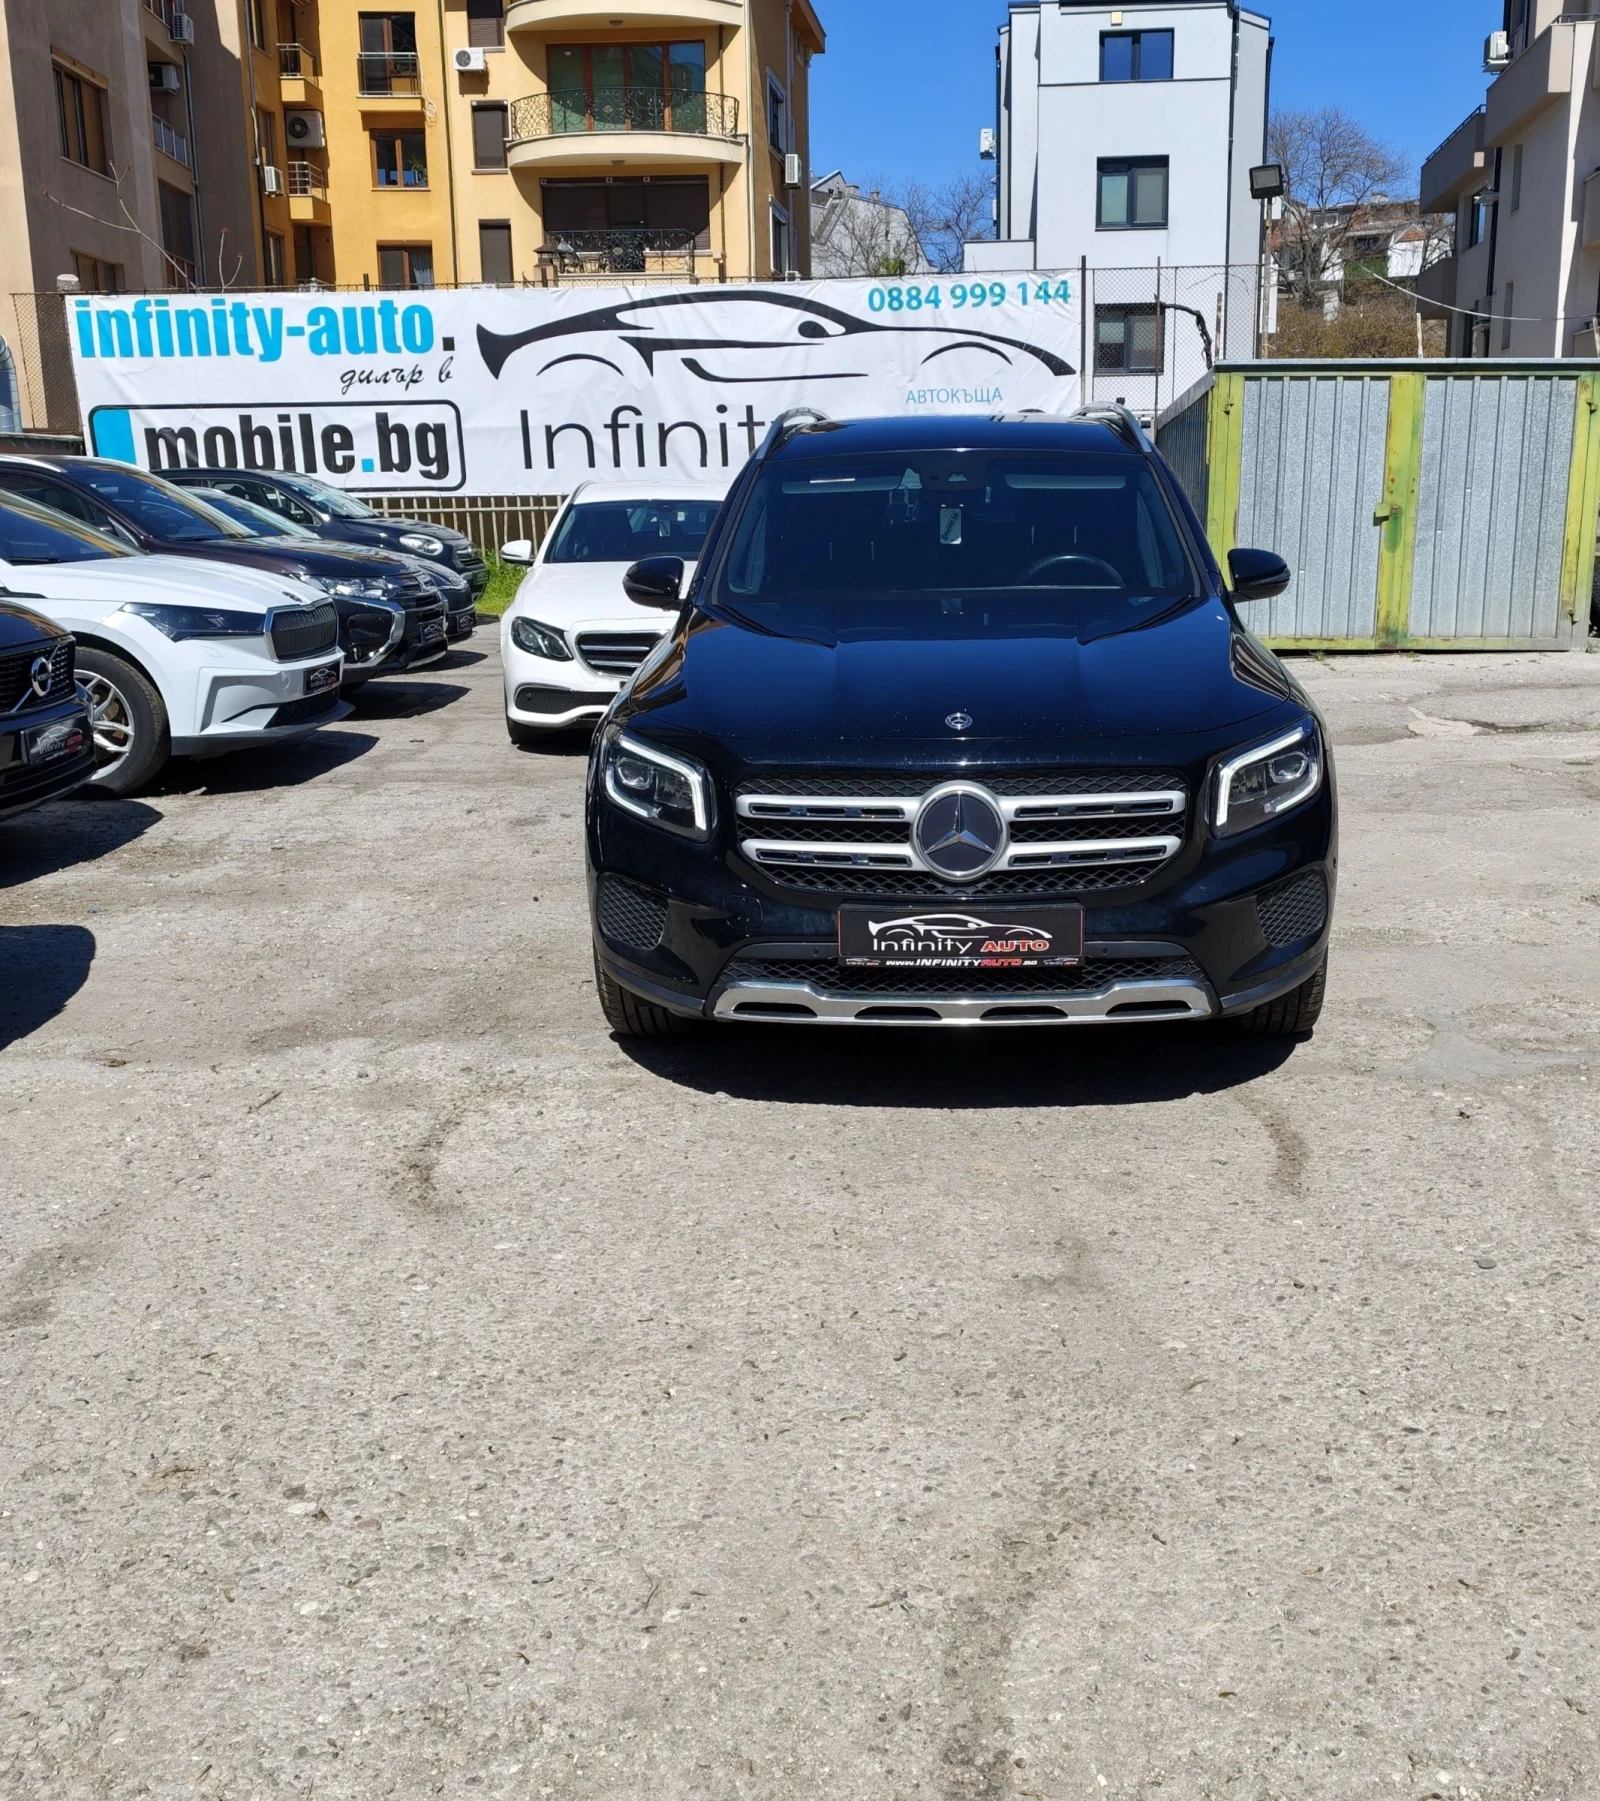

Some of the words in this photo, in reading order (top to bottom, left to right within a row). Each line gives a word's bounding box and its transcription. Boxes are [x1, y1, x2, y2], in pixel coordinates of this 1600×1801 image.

[868, 285, 942, 312] 0884
[950, 282, 1006, 308] 999
[1017, 280, 1071, 306] 144
[340, 365, 425, 395] дилър
[906, 387, 1003, 405] АВТОКЪЩА
[143, 412, 450, 481] mobile.bg
[519, 404, 772, 470] Infinit
[873, 938, 973, 954] Infinity
[980, 939, 1050, 953] AUTO
